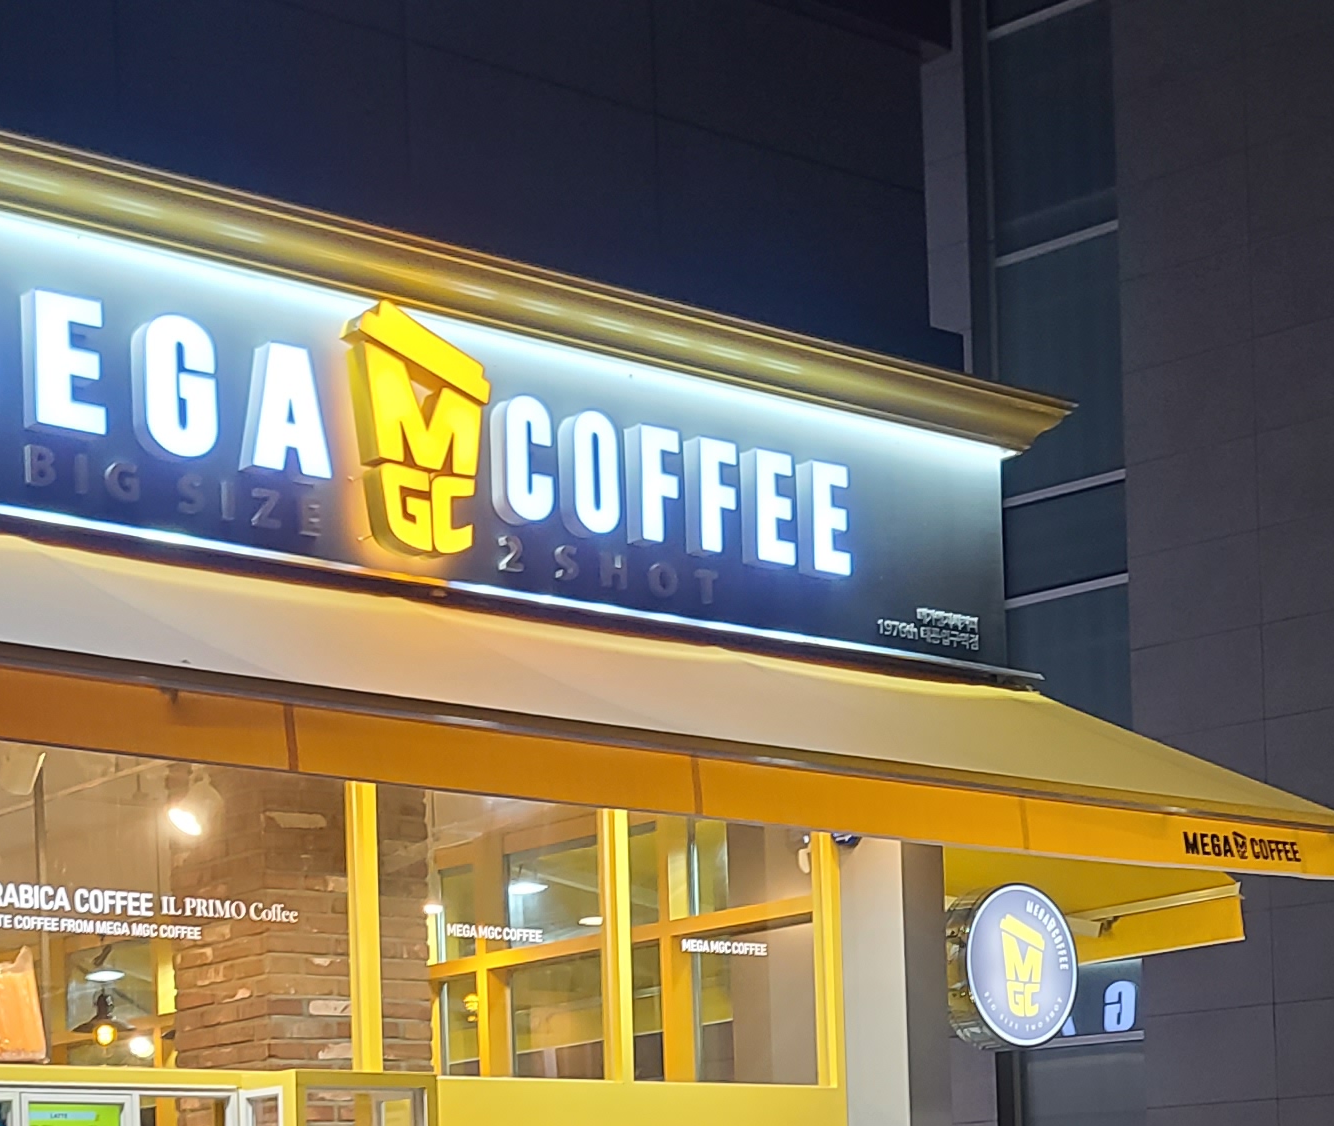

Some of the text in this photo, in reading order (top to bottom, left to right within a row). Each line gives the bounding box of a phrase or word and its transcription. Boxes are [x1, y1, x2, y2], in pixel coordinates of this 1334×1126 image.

[490, 395, 854, 580] COFFEE
[23, 444, 720, 604] BIG SIZE 2 SHOT
[1182, 831, 1235, 858] MEGA
[1250, 838, 1302, 863] COFFEE
[74, 888, 155, 918] COFFEE
[161, 896, 182, 916] IL
[183, 897, 247, 920] PRIMO
[249, 902, 299, 924] Coffee
[14, 915, 60, 932] COFFEE
[60, 917, 95, 934] FROM
[95, 919, 130, 937] MEGA
[131, 922, 158, 938] MGC
[159, 923, 202, 941] COFFEE
[447, 922, 544, 943] MEGA MGC COFFEE
[1026, 899, 1070, 971] MEGA COFFEE
[681, 938, 768, 957] MEGA MGC COFFEE
[1025, 1020, 1044, 1032] TWO
